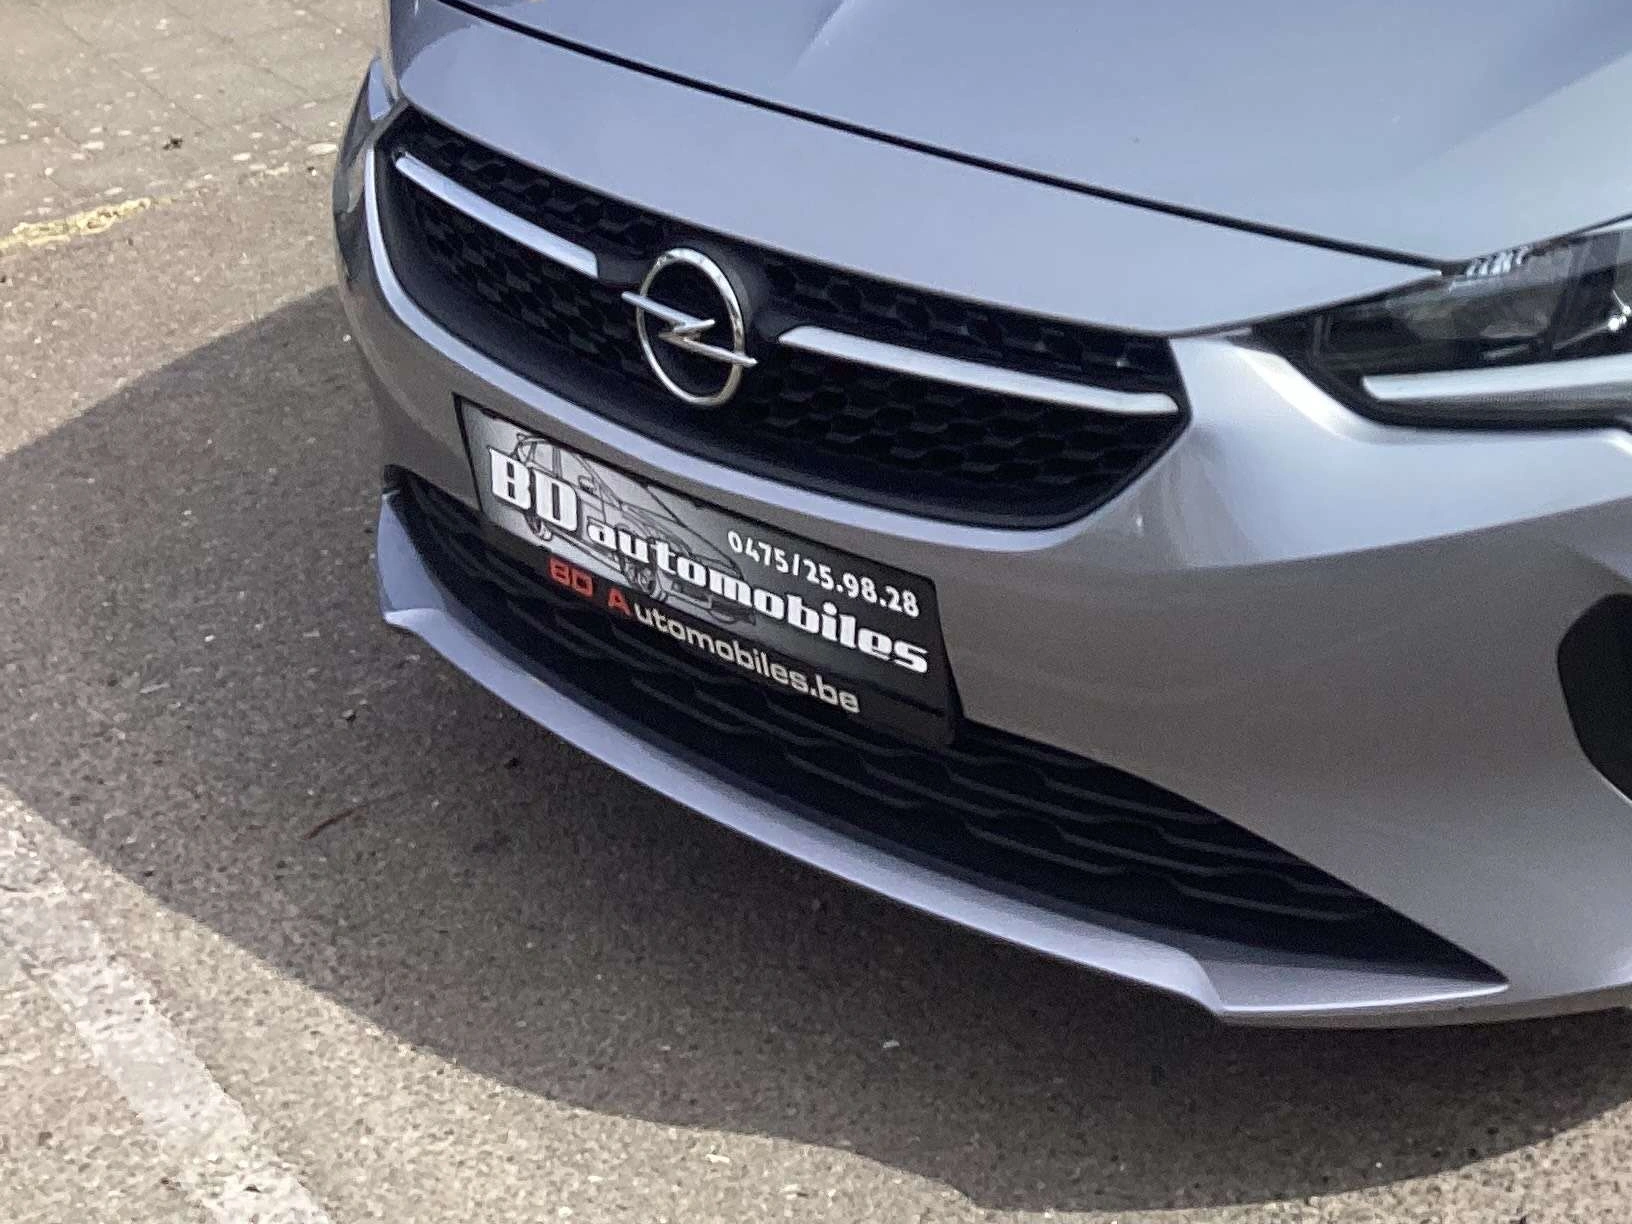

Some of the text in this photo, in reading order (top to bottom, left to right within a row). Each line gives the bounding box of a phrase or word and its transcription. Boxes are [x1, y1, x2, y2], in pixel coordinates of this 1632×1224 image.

[487, 446, 928, 674] BD automobiles
[727, 530, 920, 618] 0475/25.98.28
